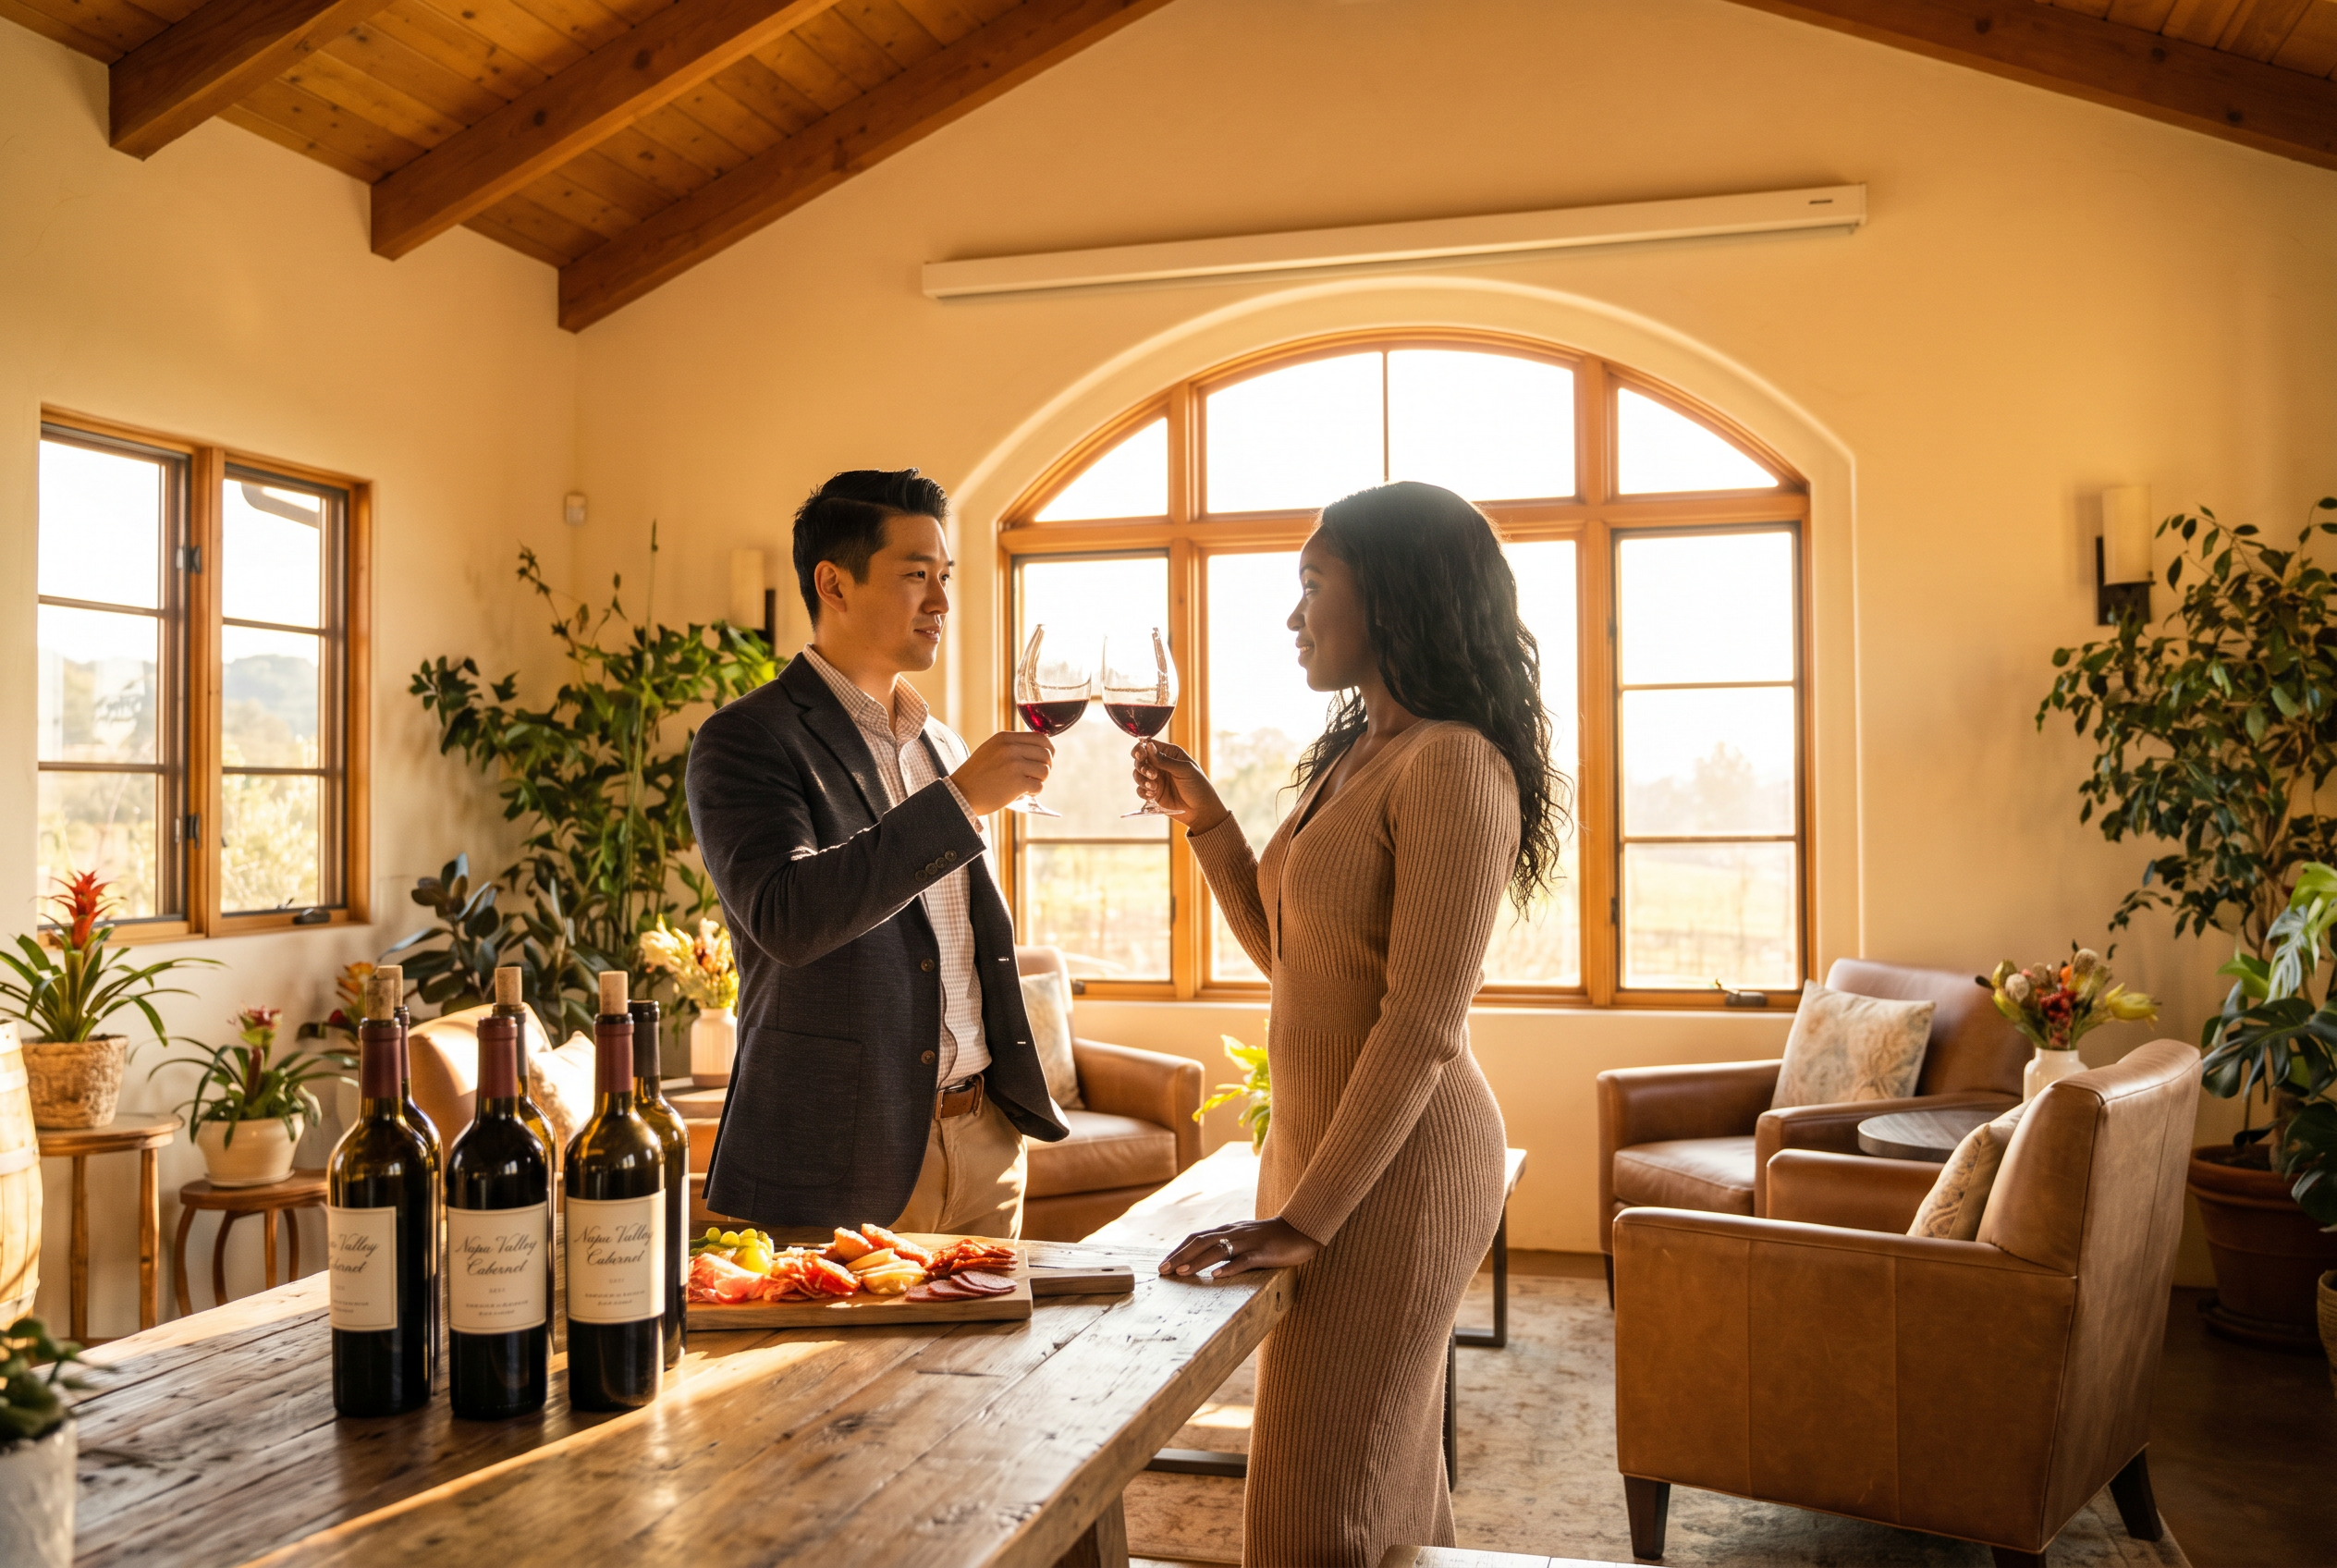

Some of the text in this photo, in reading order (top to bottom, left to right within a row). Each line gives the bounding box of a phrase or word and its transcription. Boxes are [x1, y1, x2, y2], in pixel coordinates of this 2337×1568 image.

[455, 1232, 537, 1260] Napa Valley
[573, 1225, 612, 1249] Napa
[467, 1258, 528, 1275] Cabernet
